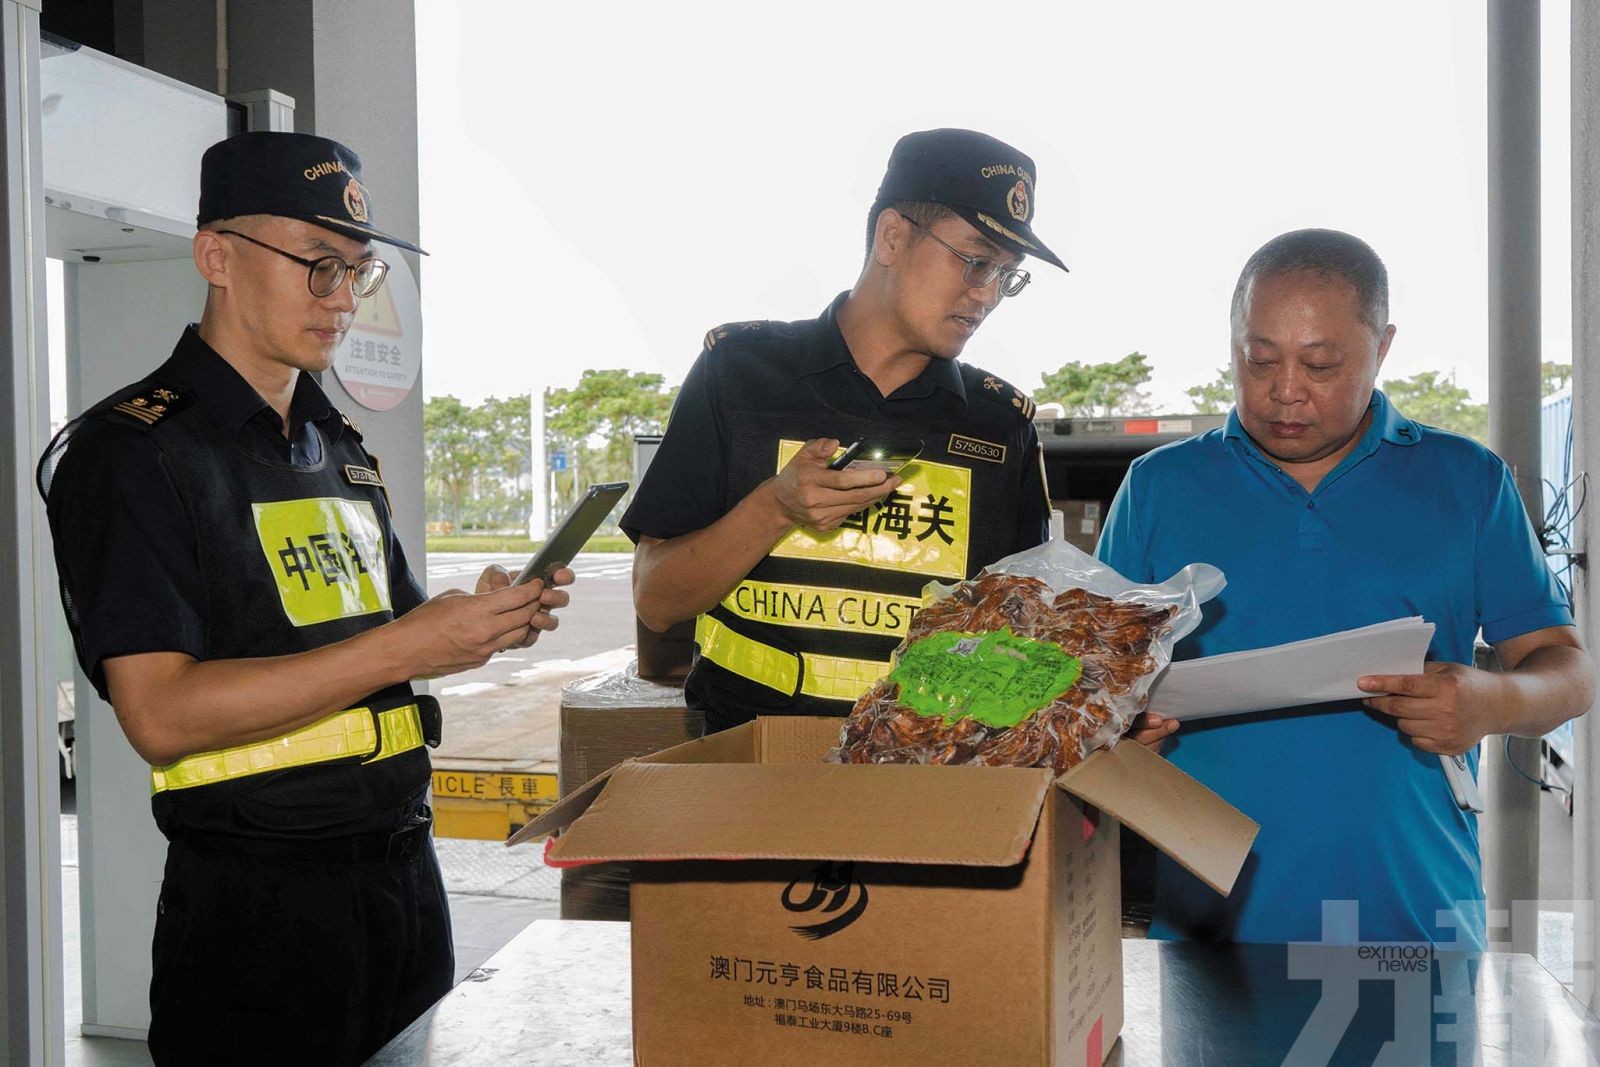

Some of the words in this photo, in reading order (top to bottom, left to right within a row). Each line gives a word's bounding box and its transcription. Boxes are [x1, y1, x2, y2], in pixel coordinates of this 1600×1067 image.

[304, 161, 346, 181] CHINA
[981, 164, 1016, 179] CHINA
[350, 338, 402, 366] 注意安全
[954, 439, 1000, 458] 5750530
[278, 531, 369, 591] 中国
[735, 586, 827, 623] CHINA
[431, 776, 485, 794] ICLE
[498, 777, 540, 798] 長車
[709, 955, 951, 1004] 澳门元亨食品有限公司
